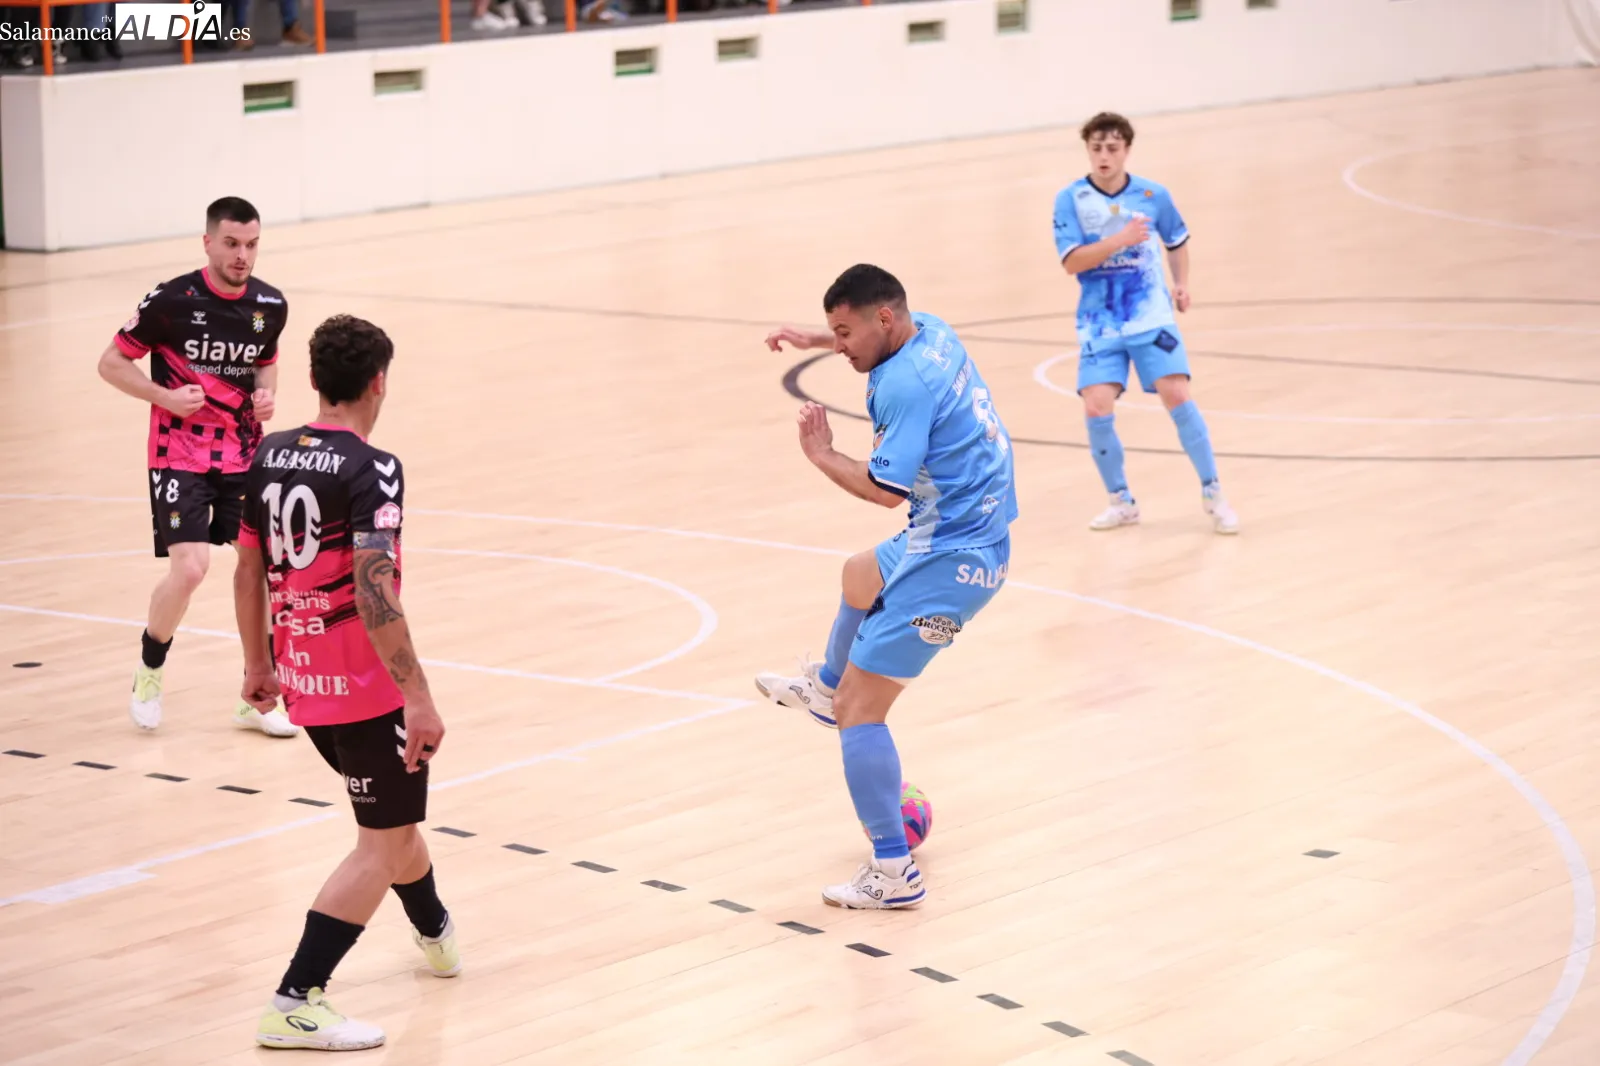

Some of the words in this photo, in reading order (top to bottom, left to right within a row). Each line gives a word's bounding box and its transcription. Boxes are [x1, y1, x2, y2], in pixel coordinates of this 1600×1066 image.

[262, 447, 347, 475] A.GASCÓN
[166, 478, 180, 503] 8
[261, 482, 322, 570] 10
